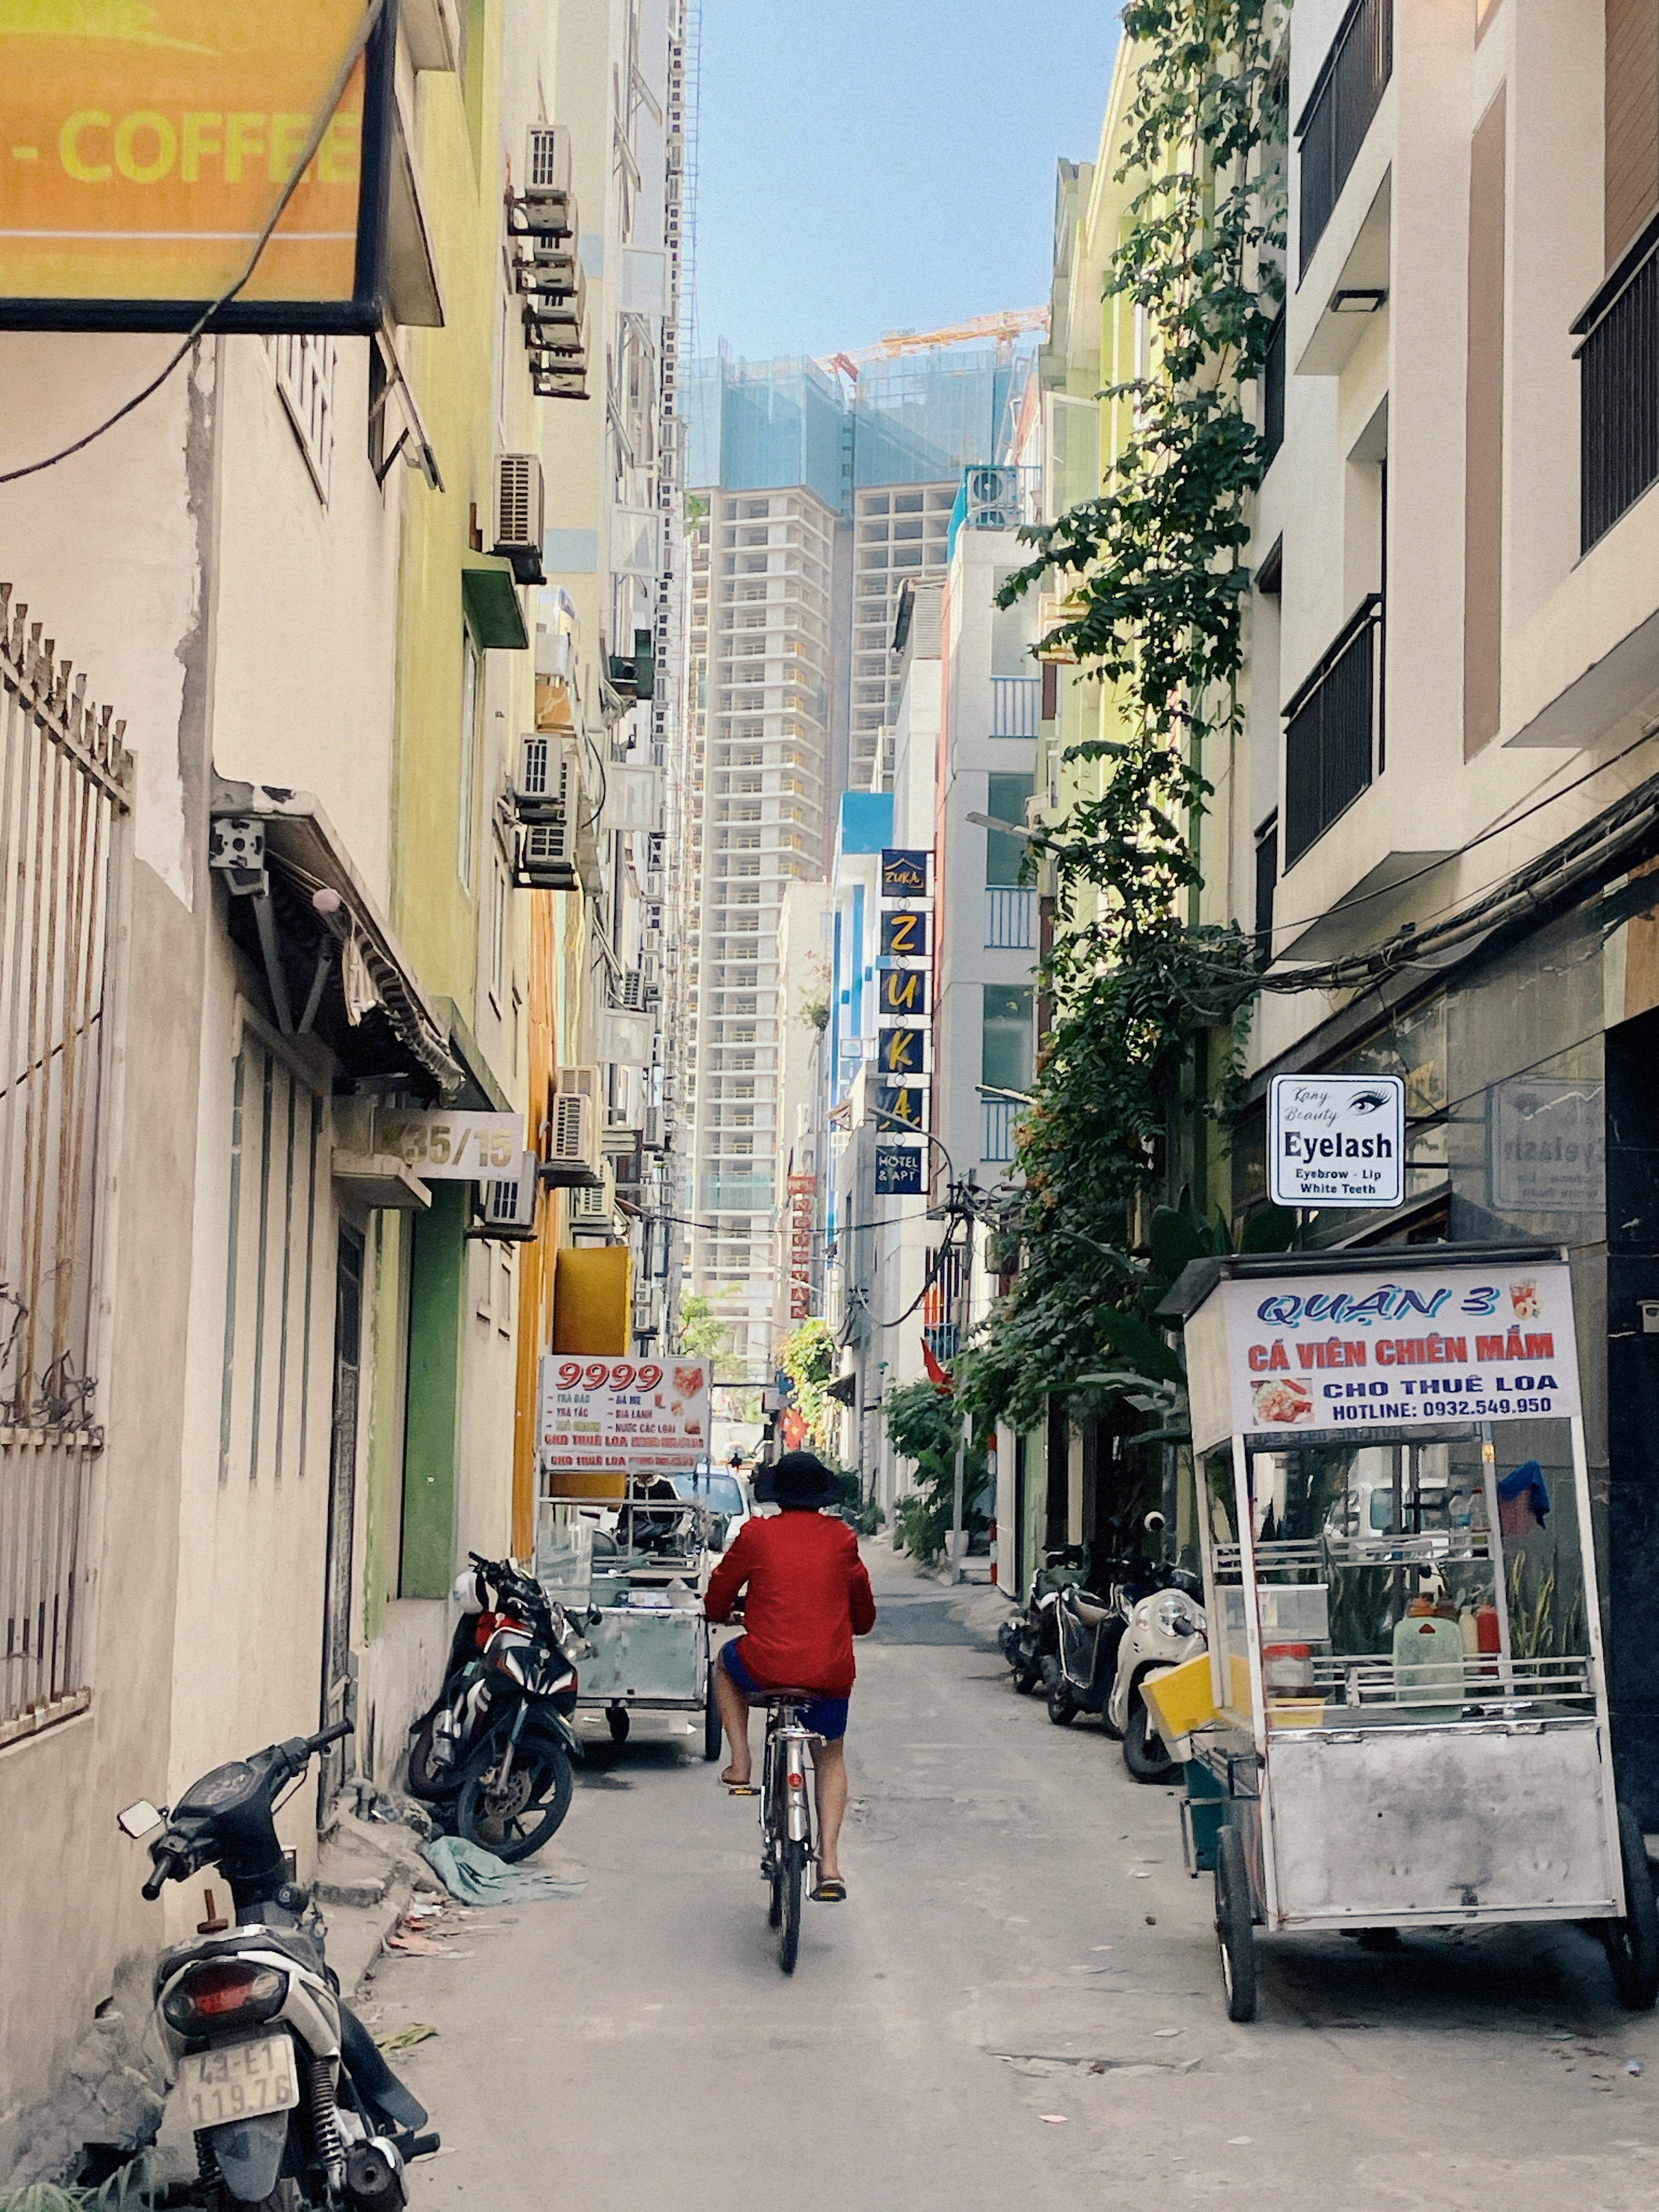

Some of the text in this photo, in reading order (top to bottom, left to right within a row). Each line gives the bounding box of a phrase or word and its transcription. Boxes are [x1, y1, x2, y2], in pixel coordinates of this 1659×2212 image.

[59, 110, 360, 184] COFFEE
[885, 870, 920, 885] ZUKA
[1284, 1106, 1340, 1128] Beauty
[1284, 1131, 1392, 1165] Eyelash
[878, 1155, 918, 1168] HOTEL
[878, 1169, 916, 1182] & APT
[1295, 1168, 1349, 1180] Eyebrow
[1362, 1168, 1382, 1182] Lip
[1300, 1183, 1376, 1194] White Teeth
[1257, 1284, 1500, 1328] QUẬN 3
[1248, 1323, 1555, 1372] CÁ VIÊN CHIÊN MẮM
[555, 1362, 663, 1392] 9999
[1323, 1374, 1559, 1399] CHO THUÊ LOA
[1332, 1397, 1552, 1421] HOTLINE: 0932.549.950
[192, 2074, 291, 2125] 119.76
